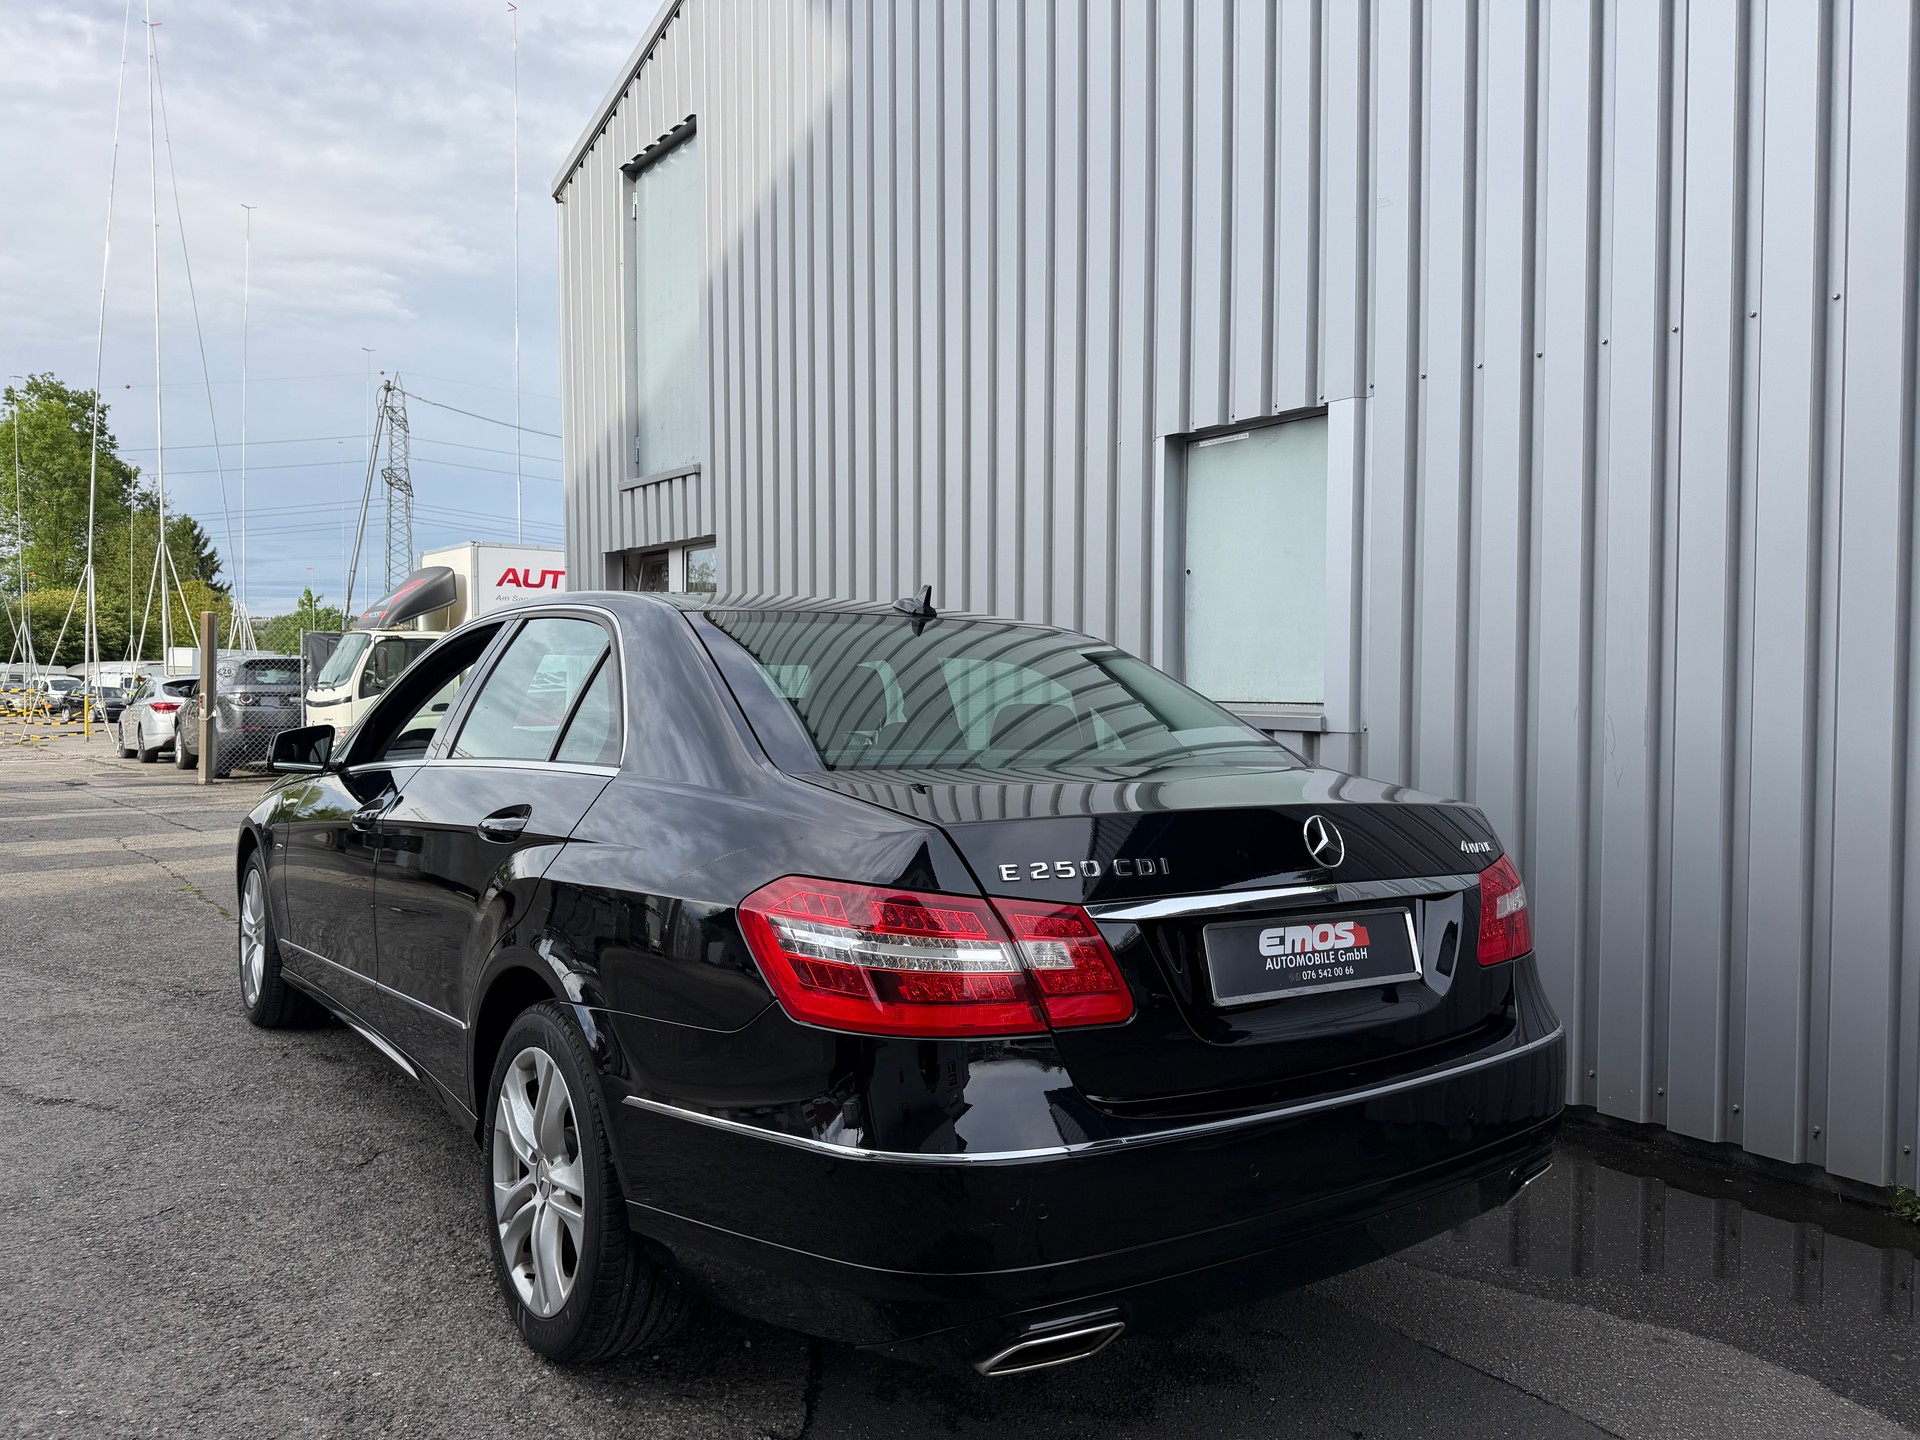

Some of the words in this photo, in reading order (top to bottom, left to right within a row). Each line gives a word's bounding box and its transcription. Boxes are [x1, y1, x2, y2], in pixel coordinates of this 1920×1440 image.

[495, 567, 566, 590] AUT
[495, 594, 510, 602] Am
[998, 863, 1021, 882] E
[1029, 860, 1102, 881] 250
[1112, 857, 1170, 877] CDI
[1265, 951, 1336, 971] AUTOMOBILE
[1337, 947, 1368, 962] GmbH
[1301, 970, 1317, 981] 076
[1318, 968, 1333, 979] 542
[1333, 966, 1344, 977] 00
[1345, 965, 1354, 976] 66
